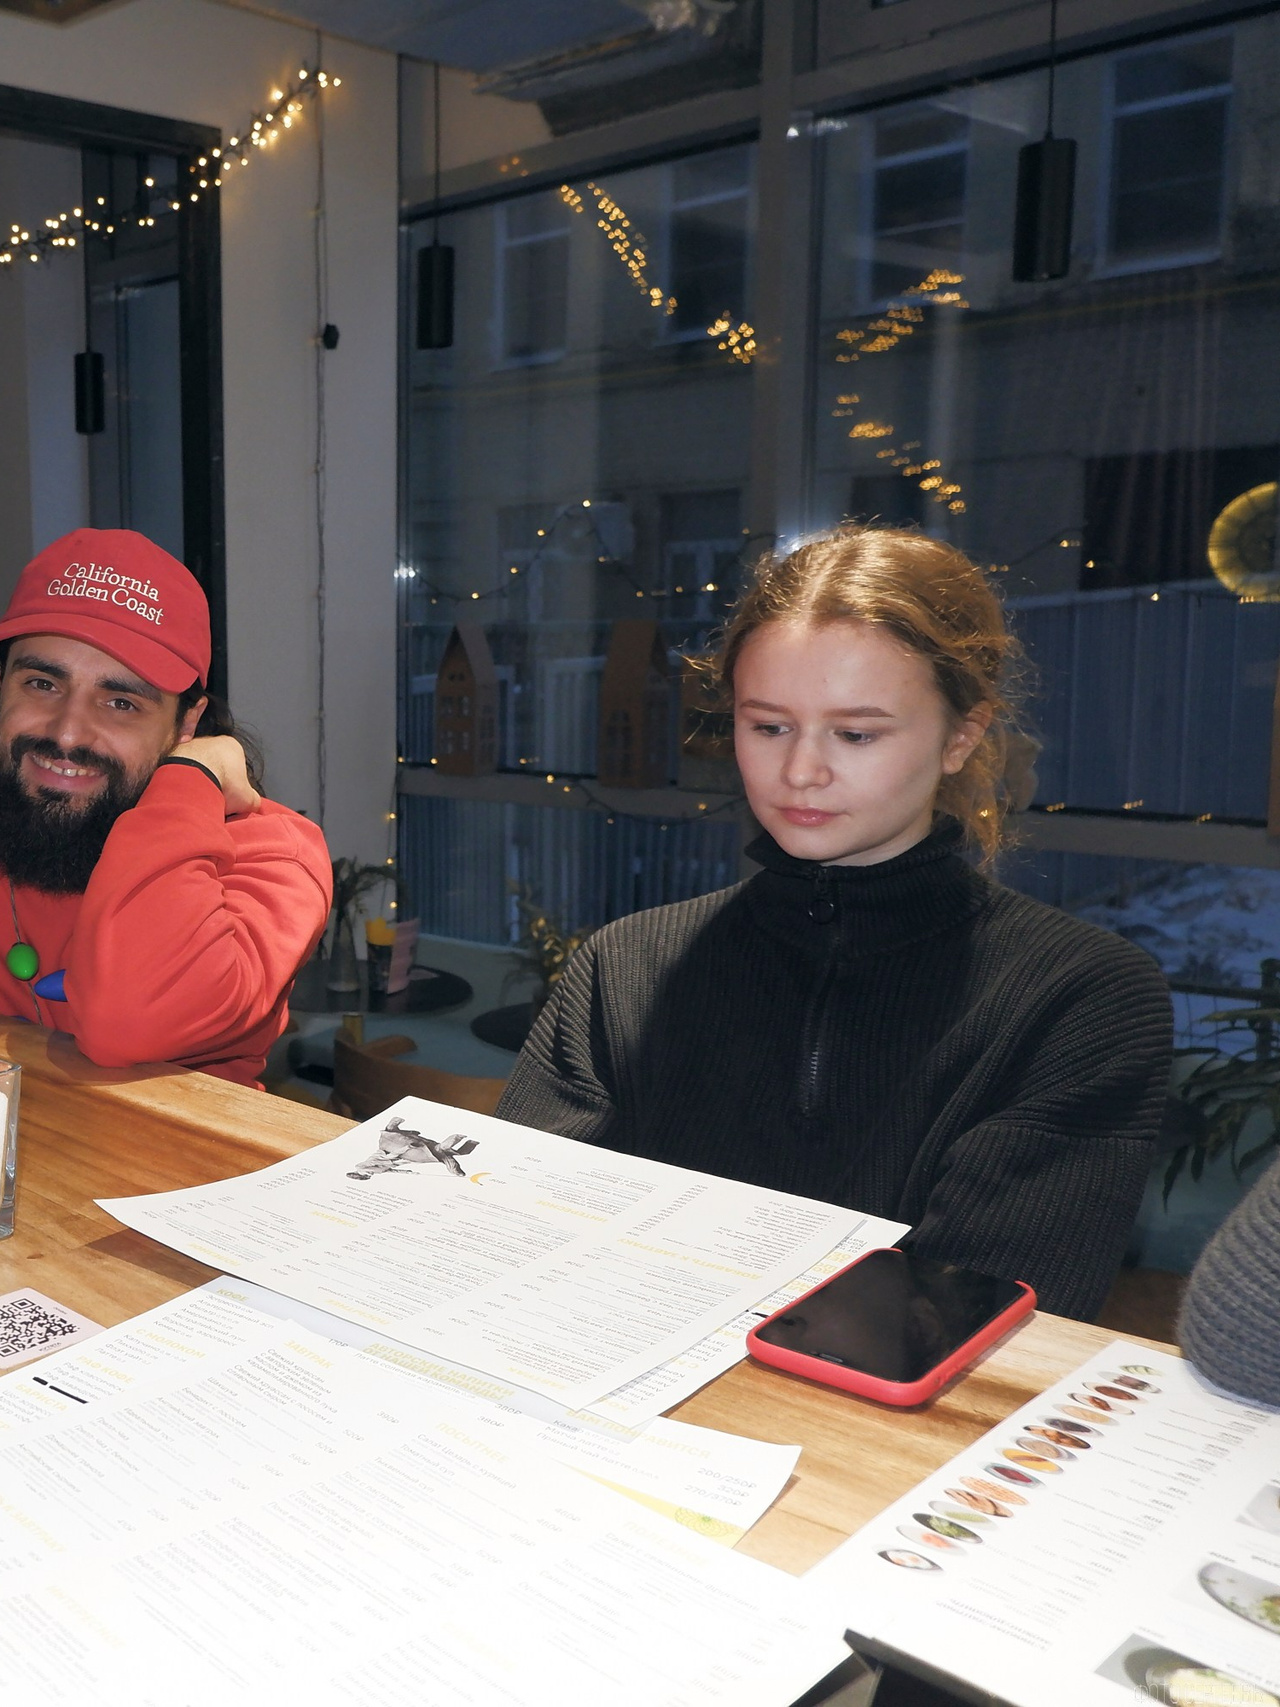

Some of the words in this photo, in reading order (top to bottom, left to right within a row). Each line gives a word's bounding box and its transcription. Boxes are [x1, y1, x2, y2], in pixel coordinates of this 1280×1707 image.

[64, 562, 160, 602] California
[47, 578, 108, 602] Golden
[111, 588, 165, 625] Coast
[534, 1199, 608, 1222] ИНТЕРЕСНОЕ
[616, 1237, 677, 1256] ЗАВТРАКУ
[690, 1257, 761, 1280] ДОБАВИТЬ
[215, 1288, 248, 1302] КОФЕ
[179, 1307, 222, 1325] Американо
[196, 1298, 260, 1323] Альтернативный
[170, 1312, 230, 1336] Австралийский
[113, 1338, 147, 1354] Пикколо
[122, 1333, 161, 1351] Капучино
[146, 1332, 207, 1358] МОЛОКОМ
[282, 1339, 335, 1369] ЗАВТРАК
[75, 1355, 103, 1369] РАФ
[100, 1366, 134, 1383] КОФЕ
[368, 1342, 445, 1372] АВТОРСКИЕ
[447, 1369, 515, 1396] НАПИТКИ
[378, 1353, 430, 1374] НАШЕЙ
[429, 1371, 505, 1401] КОМАНДЫ
[13, 1384, 67, 1411] БАРИСТА
[434, 1422, 509, 1463] ПОСЫТНЕЕ
[603, 1421, 711, 1459] ПОНРАВИТСЯ
[10, 1511, 66, 1553] ЗАВТРАКУ
